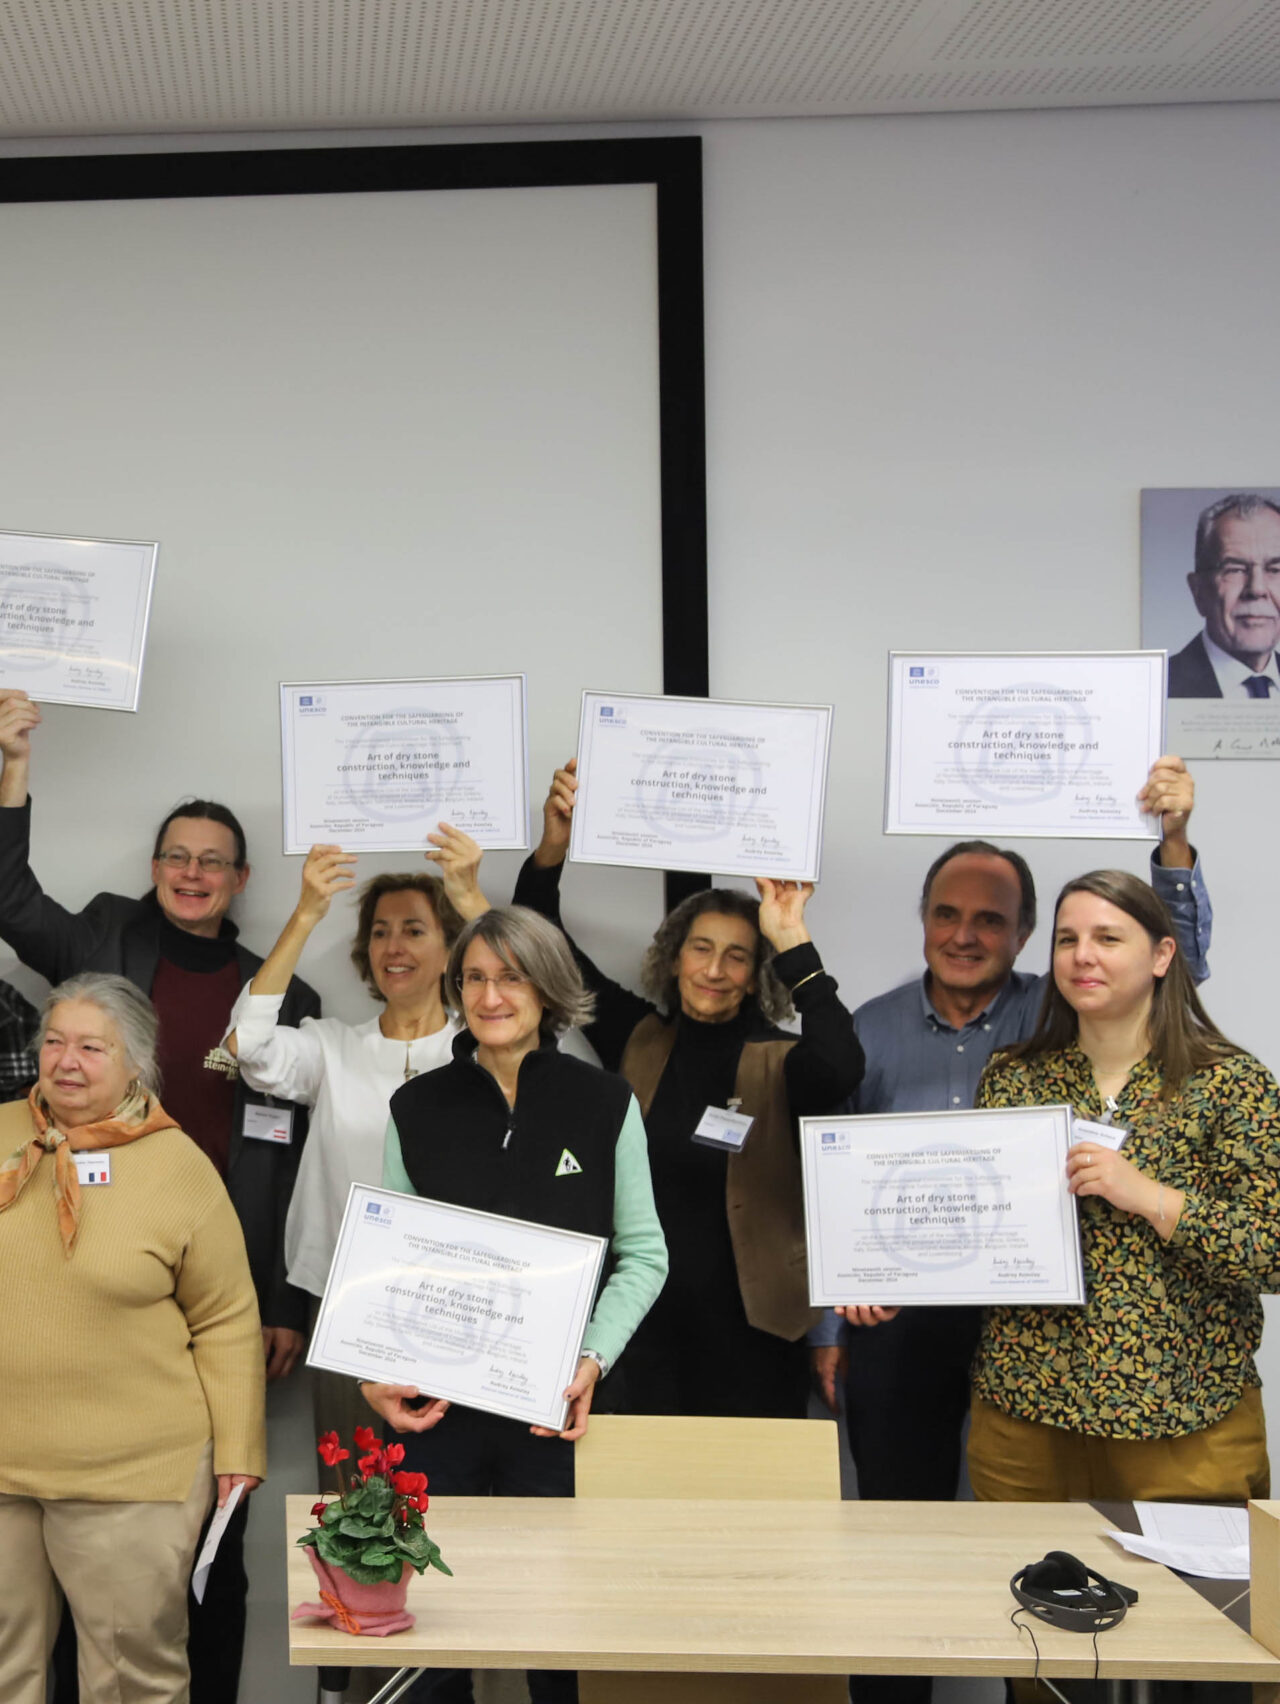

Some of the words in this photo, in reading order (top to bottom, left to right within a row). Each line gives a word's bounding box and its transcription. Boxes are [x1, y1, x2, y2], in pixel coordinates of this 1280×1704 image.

[0, 601, 13, 610] Art
[15, 603, 24, 611] of
[25, 604, 40, 614] dry
[41, 607, 67, 615] stone
[28, 613, 75, 626] knowledge
[77, 619, 94, 627] and
[7, 621, 54, 633] techniques
[982, 730, 998, 738] Art
[1001, 730, 1012, 738] of
[1014, 730, 1031, 741] dry
[948, 740, 1016, 750] construction,
[1019, 740, 1075, 751] knowledge
[1078, 741, 1098, 750] and
[367, 753, 381, 761] Art
[383, 752, 393, 760] of
[395, 752, 410, 762] dry
[994, 750, 1051, 761] techniques
[337, 762, 397, 771] construction,
[400, 760, 450, 770] knowledge
[452, 760, 470, 768] and
[378, 771, 428, 780] techniques
[662, 770, 677, 778] Art
[679, 771, 689, 779] of
[691, 772, 706, 782] dry
[708, 775, 736, 783] stone
[630, 779, 692, 790] construction,
[695, 781, 746, 794] knowledge
[672, 790, 723, 802] techniques
[897, 1195, 912, 1203] Art
[914, 1193, 925, 1203] of
[927, 1193, 944, 1205] dry
[946, 1194, 976, 1202] stone
[864, 1205, 930, 1214] construction,
[933, 1203, 988, 1213] knowledge
[991, 1202, 1011, 1211] and
[363, 1213, 392, 1225] unesco
[909, 1214, 965, 1225] techniques
[418, 1281, 434, 1292] Art
[435, 1286, 447, 1294] of
[447, 1288, 464, 1300] dry
[465, 1294, 494, 1307] stone
[384, 1284, 446, 1307] construction,
[449, 1298, 502, 1320] knowledge
[504, 1314, 524, 1325] and
[425, 1304, 478, 1324] techniques
